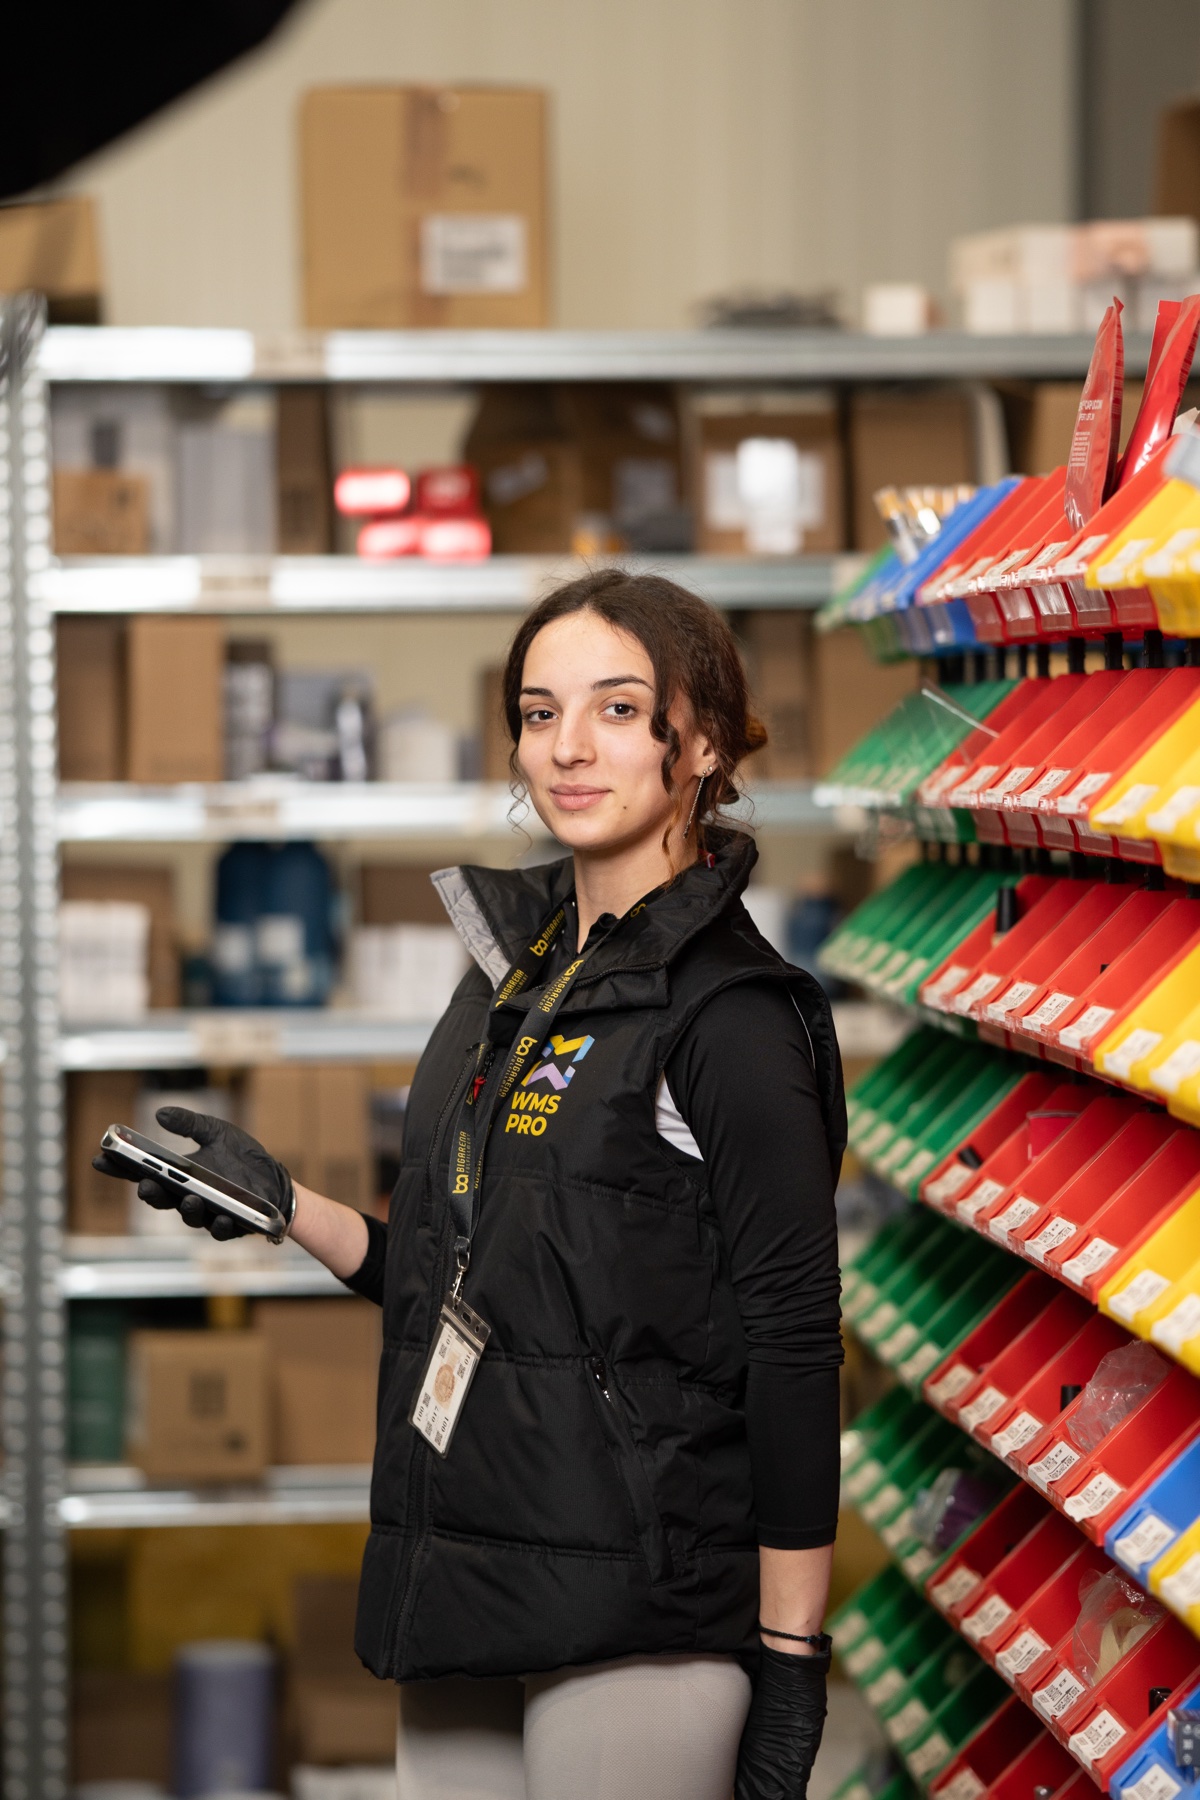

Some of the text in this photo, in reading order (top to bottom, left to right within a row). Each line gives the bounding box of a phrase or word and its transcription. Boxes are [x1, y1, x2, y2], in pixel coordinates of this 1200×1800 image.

[498, 968, 525, 1000] BIGARENA
[541, 976, 571, 1013] BIGARENA
[500, 1056, 525, 1098] BIGARENA
[511, 1091, 562, 1115] WMS
[504, 1113, 548, 1137] PRO
[456, 1130, 467, 1173] BIGARENA
